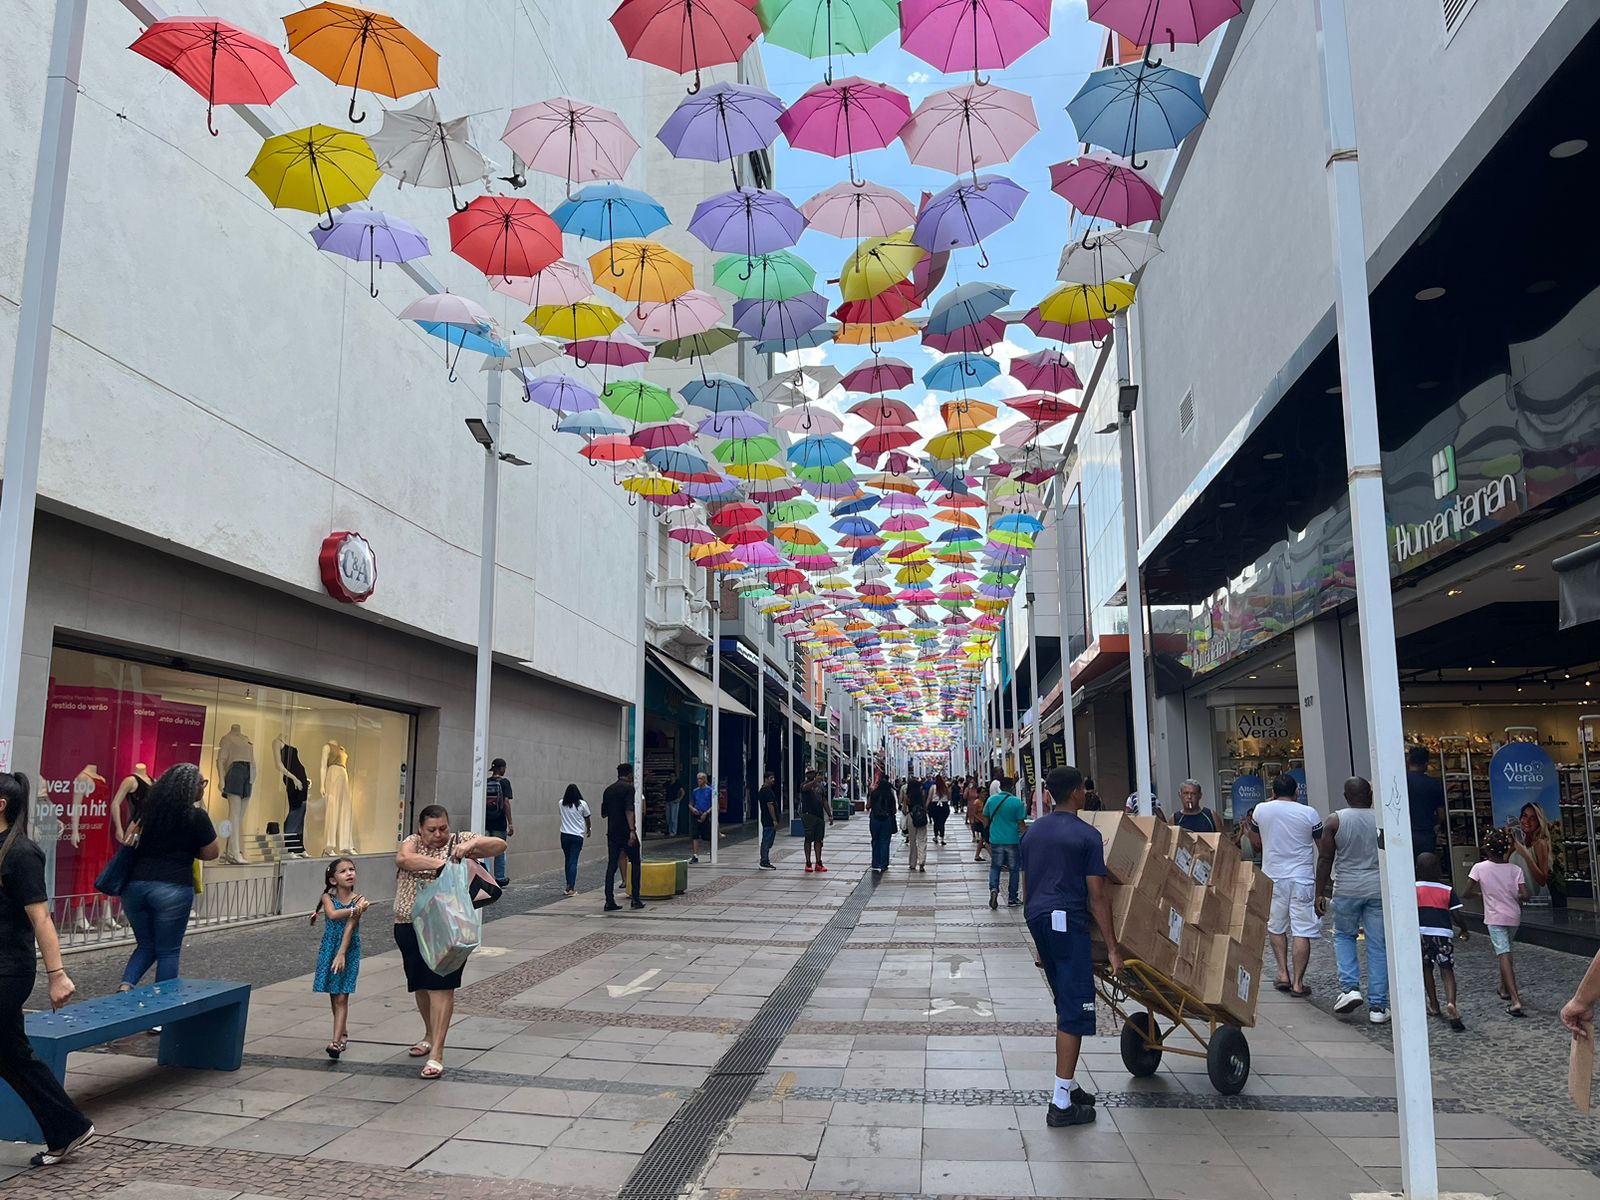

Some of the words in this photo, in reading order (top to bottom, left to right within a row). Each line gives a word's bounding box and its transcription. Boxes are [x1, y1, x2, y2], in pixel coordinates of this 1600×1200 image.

[1393, 474, 1516, 562] Humanitarian
[343, 549, 369, 586] C&A
[1238, 715, 1274, 726] Alto
[1239, 726, 1289, 738] Verão
[1023, 754, 1036, 785] OUTLET
[1503, 761, 1533, 772] Alto
[1504, 772, 1544, 782] Verão
[47, 780, 70, 793] vez
[73, 779, 95, 797] top
[66, 803, 88, 816] um
[89, 799, 107, 817] hit
